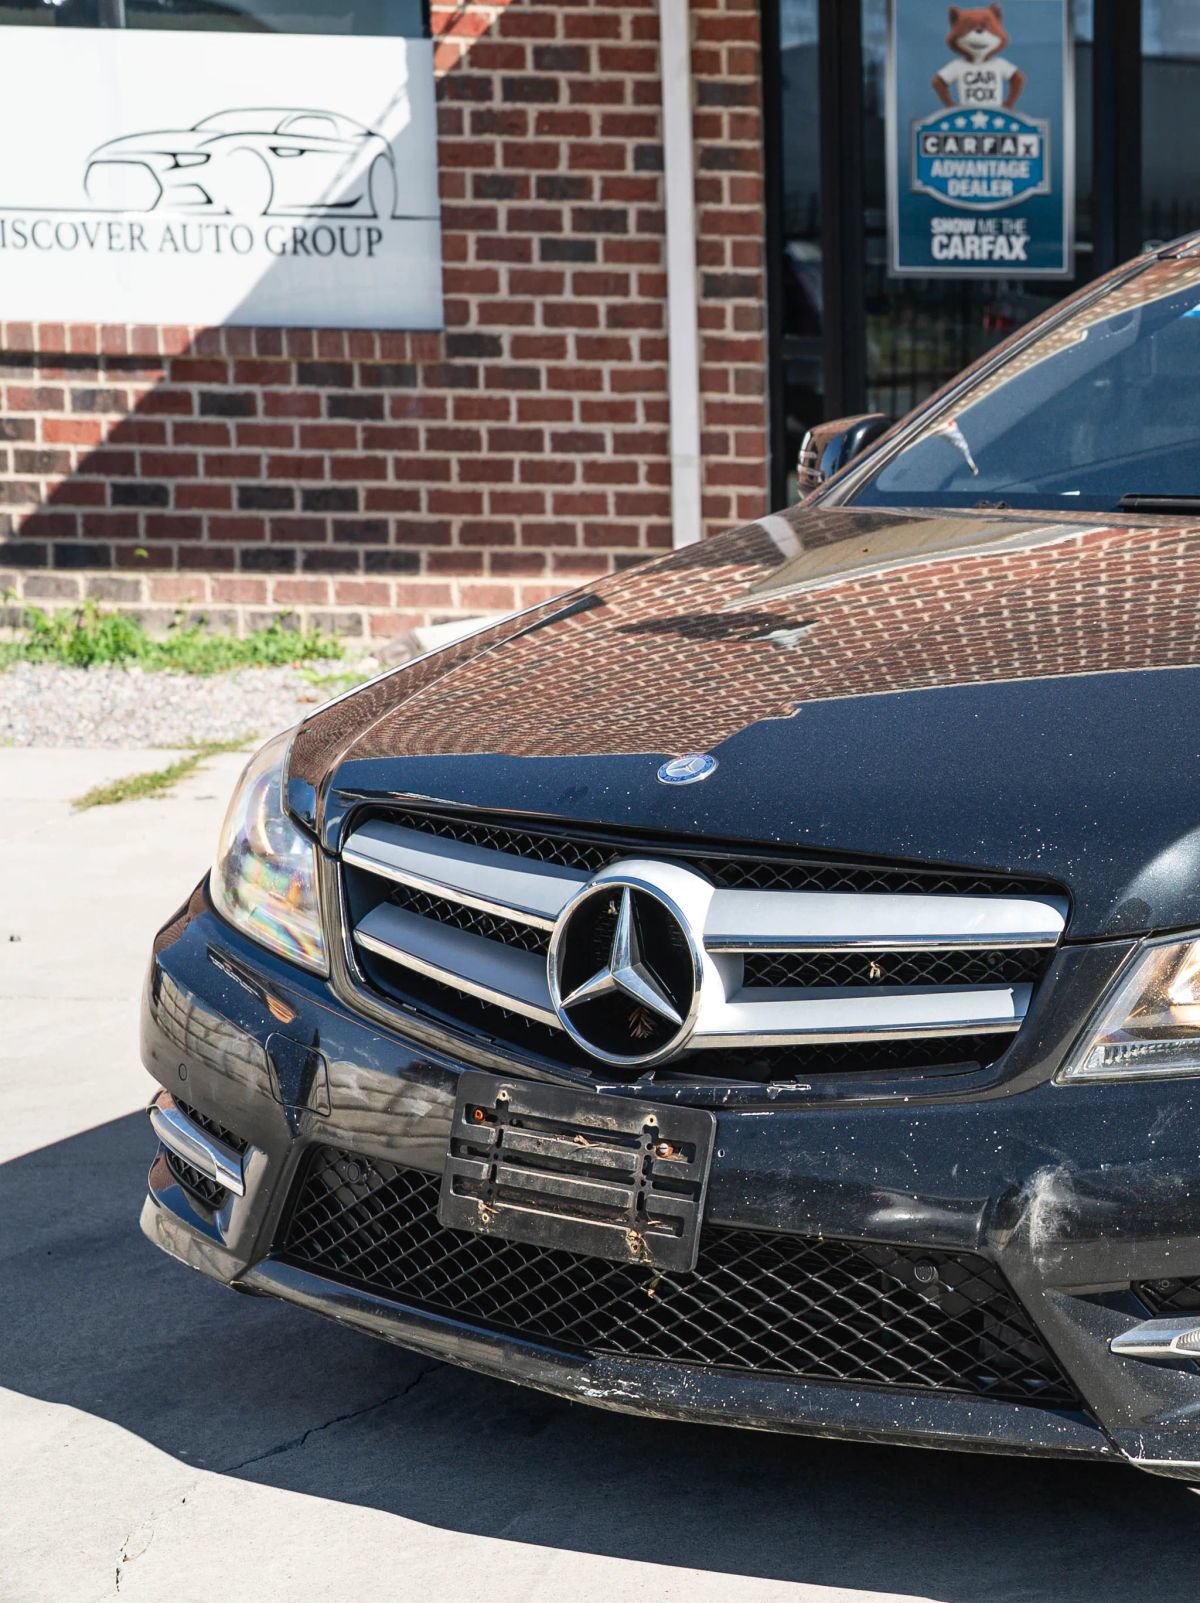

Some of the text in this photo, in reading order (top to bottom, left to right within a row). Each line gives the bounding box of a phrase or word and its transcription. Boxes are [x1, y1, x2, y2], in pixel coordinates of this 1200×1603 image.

[963, 71, 997, 86] CAR
[964, 87, 997, 102] FOX
[925, 136, 1037, 156] CARFAX
[930, 160, 1031, 178] ADVANTAGE
[947, 179, 1015, 197] DEALER
[931, 217, 1028, 234] SHOW ME THE
[0, 219, 384, 258] ISCOVER AUTO GROUP
[931, 234, 1028, 260] CARFAX
